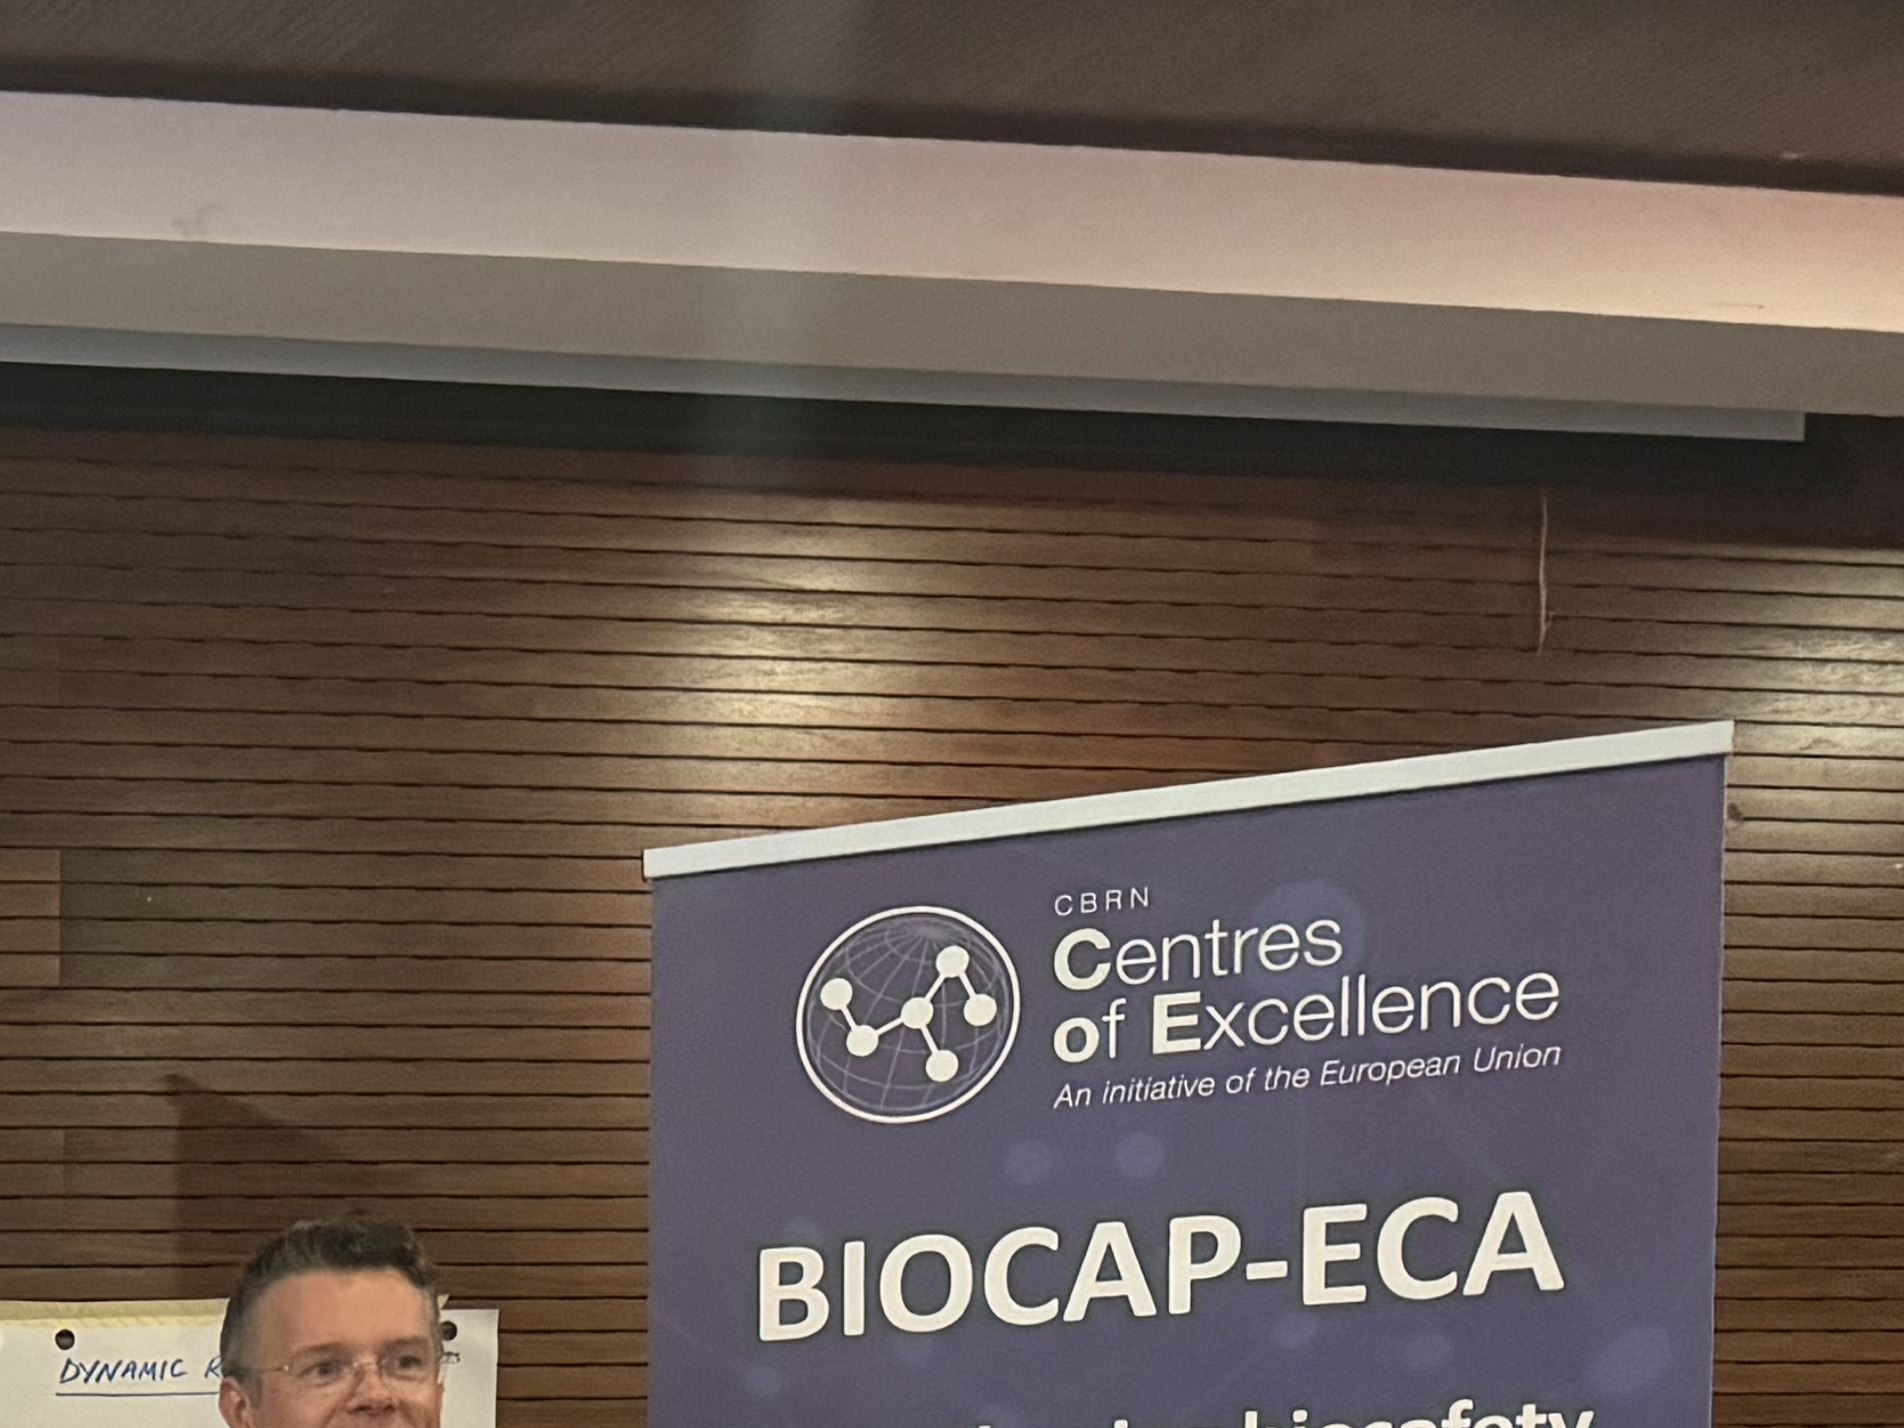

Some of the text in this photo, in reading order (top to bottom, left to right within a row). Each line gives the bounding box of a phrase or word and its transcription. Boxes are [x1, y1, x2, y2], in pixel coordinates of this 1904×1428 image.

[1054, 887, 1151, 917] CBRN
[1054, 917, 1344, 991] Centres
[1054, 969, 1561, 1064] of Excellence
[1053, 1041, 1563, 1110] An initiative of the European Union
[758, 1191, 1565, 1342] BIOCAP-ECA
[58, 1357, 189, 1386] DYNAMIC
